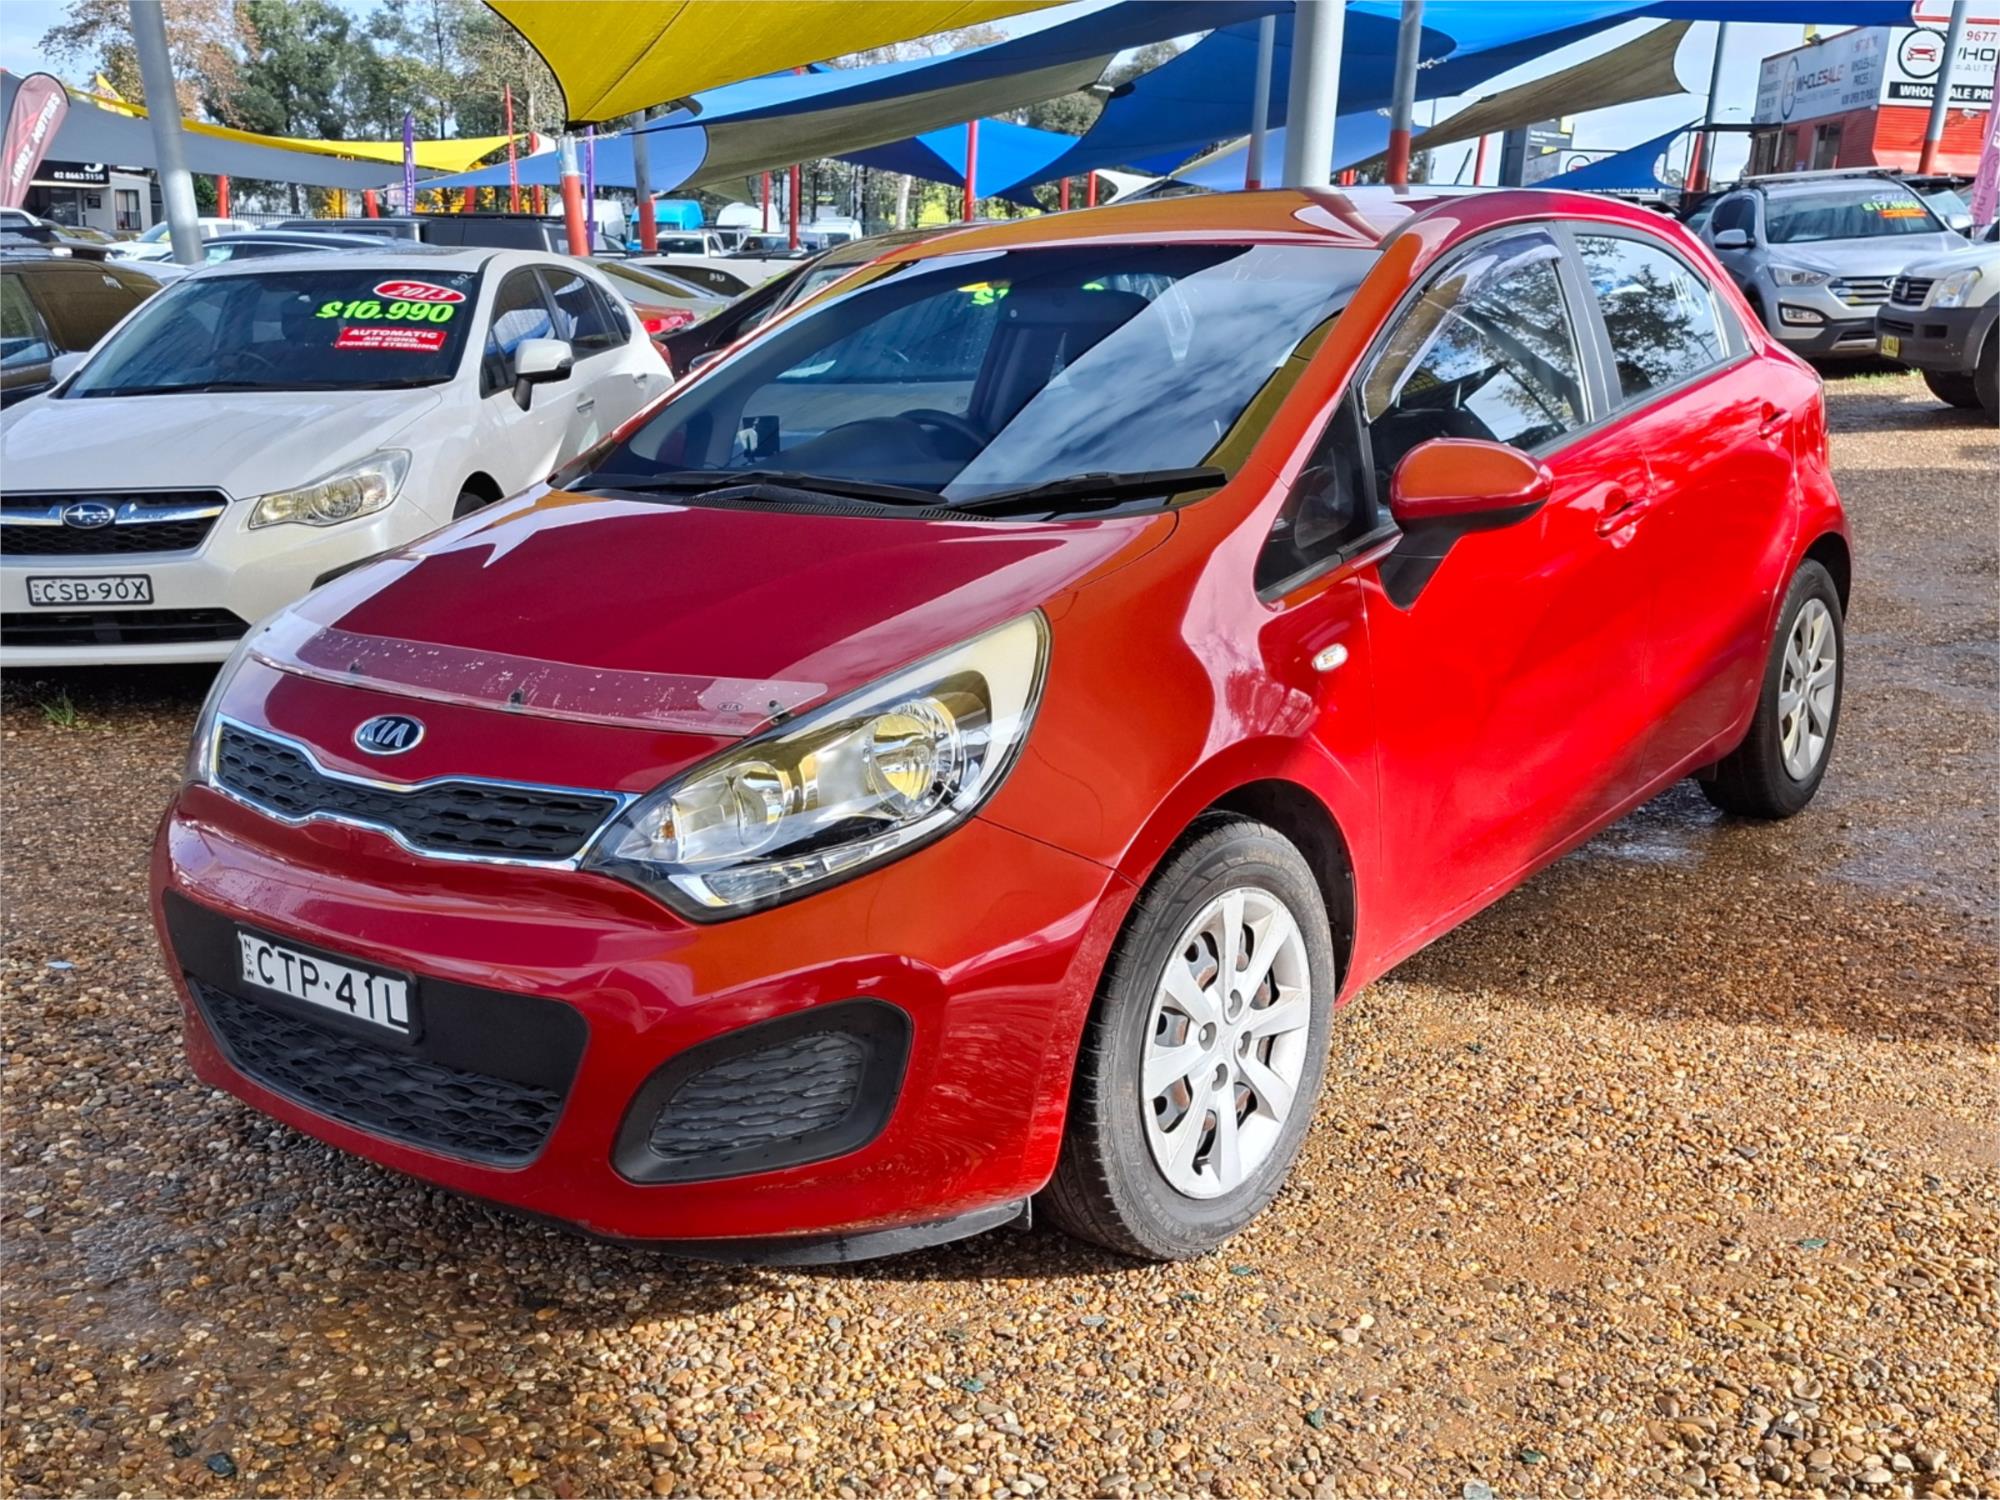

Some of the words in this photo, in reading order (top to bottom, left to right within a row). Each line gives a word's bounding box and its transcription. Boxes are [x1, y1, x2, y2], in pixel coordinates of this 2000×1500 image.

[1958, 47, 1996, 61] HO
[388, 285, 453, 300] 2013
[348, 329, 438, 339] AUTOMATIC
[381, 342, 439, 350] STEERING
[360, 719, 410, 748] KIA
